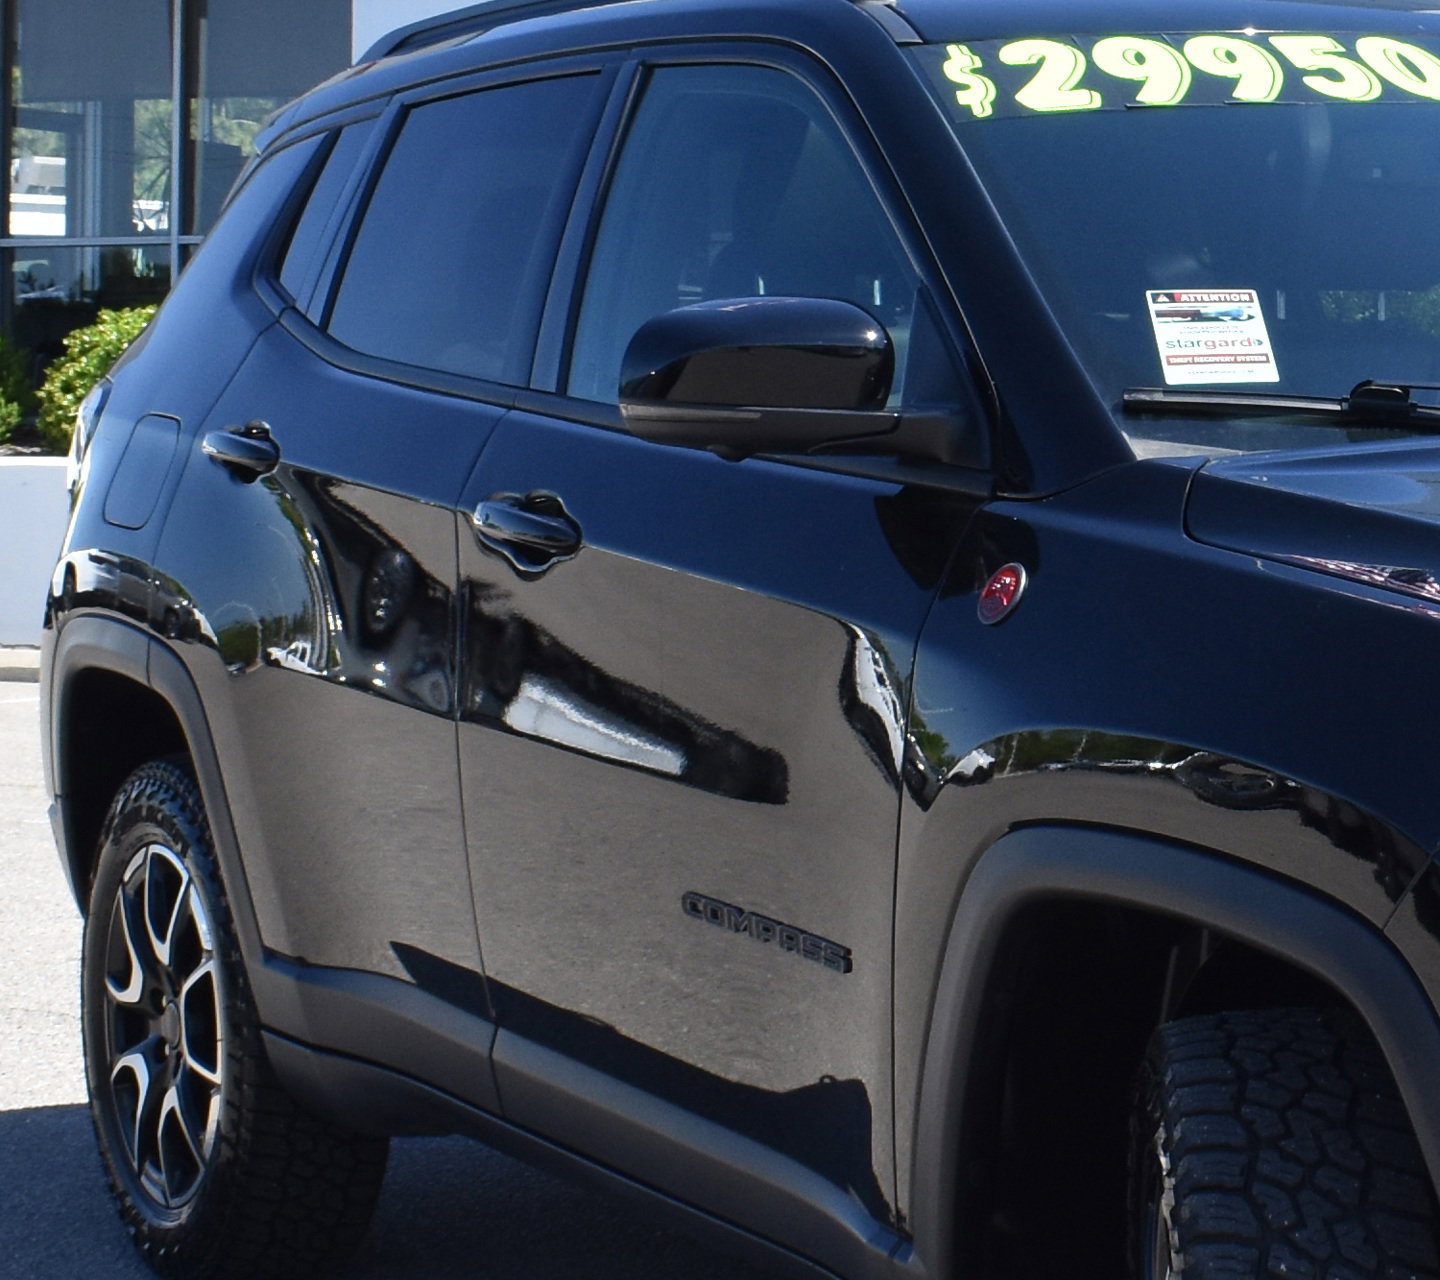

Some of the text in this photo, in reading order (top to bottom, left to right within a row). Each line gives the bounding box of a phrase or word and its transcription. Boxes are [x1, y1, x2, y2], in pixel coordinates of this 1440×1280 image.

[1180, 294, 1251, 302] ATTENTION
[1165, 337, 1253, 350] stargard
[1167, 354, 1268, 365] THEFT RECOVERY SYSTEM
[681, 890, 853, 974] COMPASS
